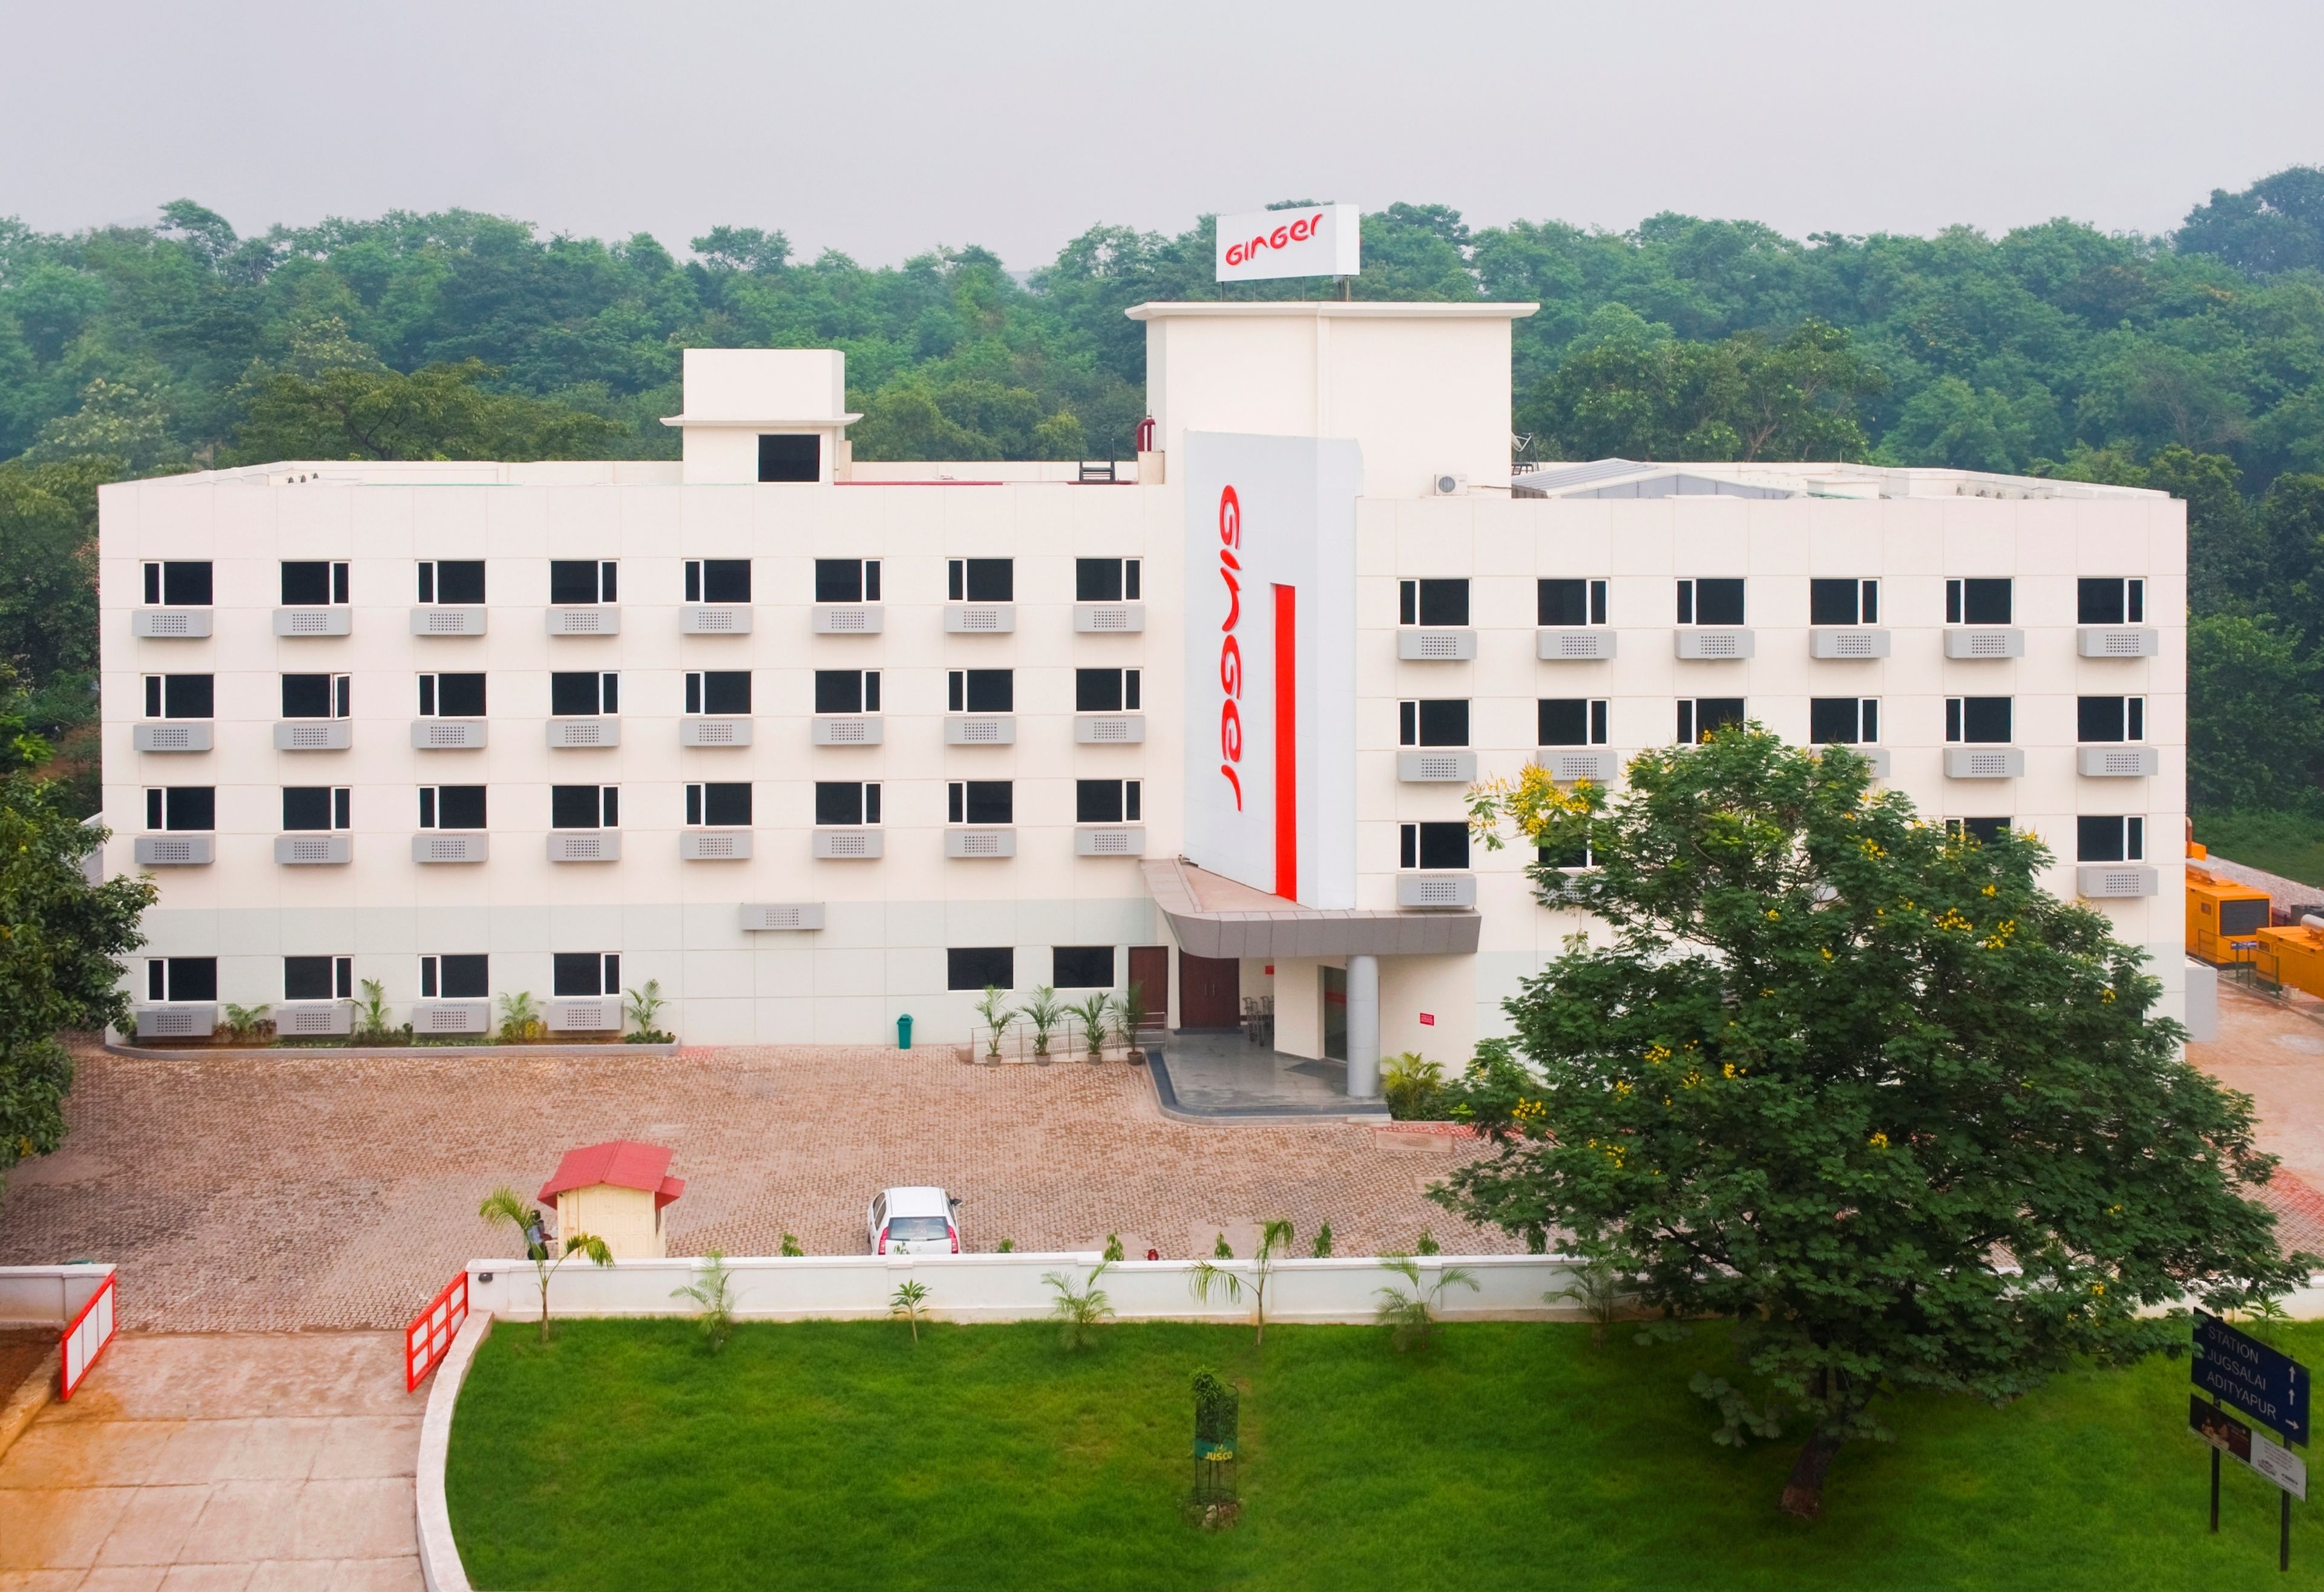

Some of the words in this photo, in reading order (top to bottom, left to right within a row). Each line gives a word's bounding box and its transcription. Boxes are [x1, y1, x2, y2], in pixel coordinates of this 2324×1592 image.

[2208, 1326, 2259, 1364] STATION
[2207, 1349, 2266, 1390] JUGSALAI
[2207, 1371, 2276, 1420] ADITYAPUR
[1204, 1451, 1233, 1461] JUSCO
